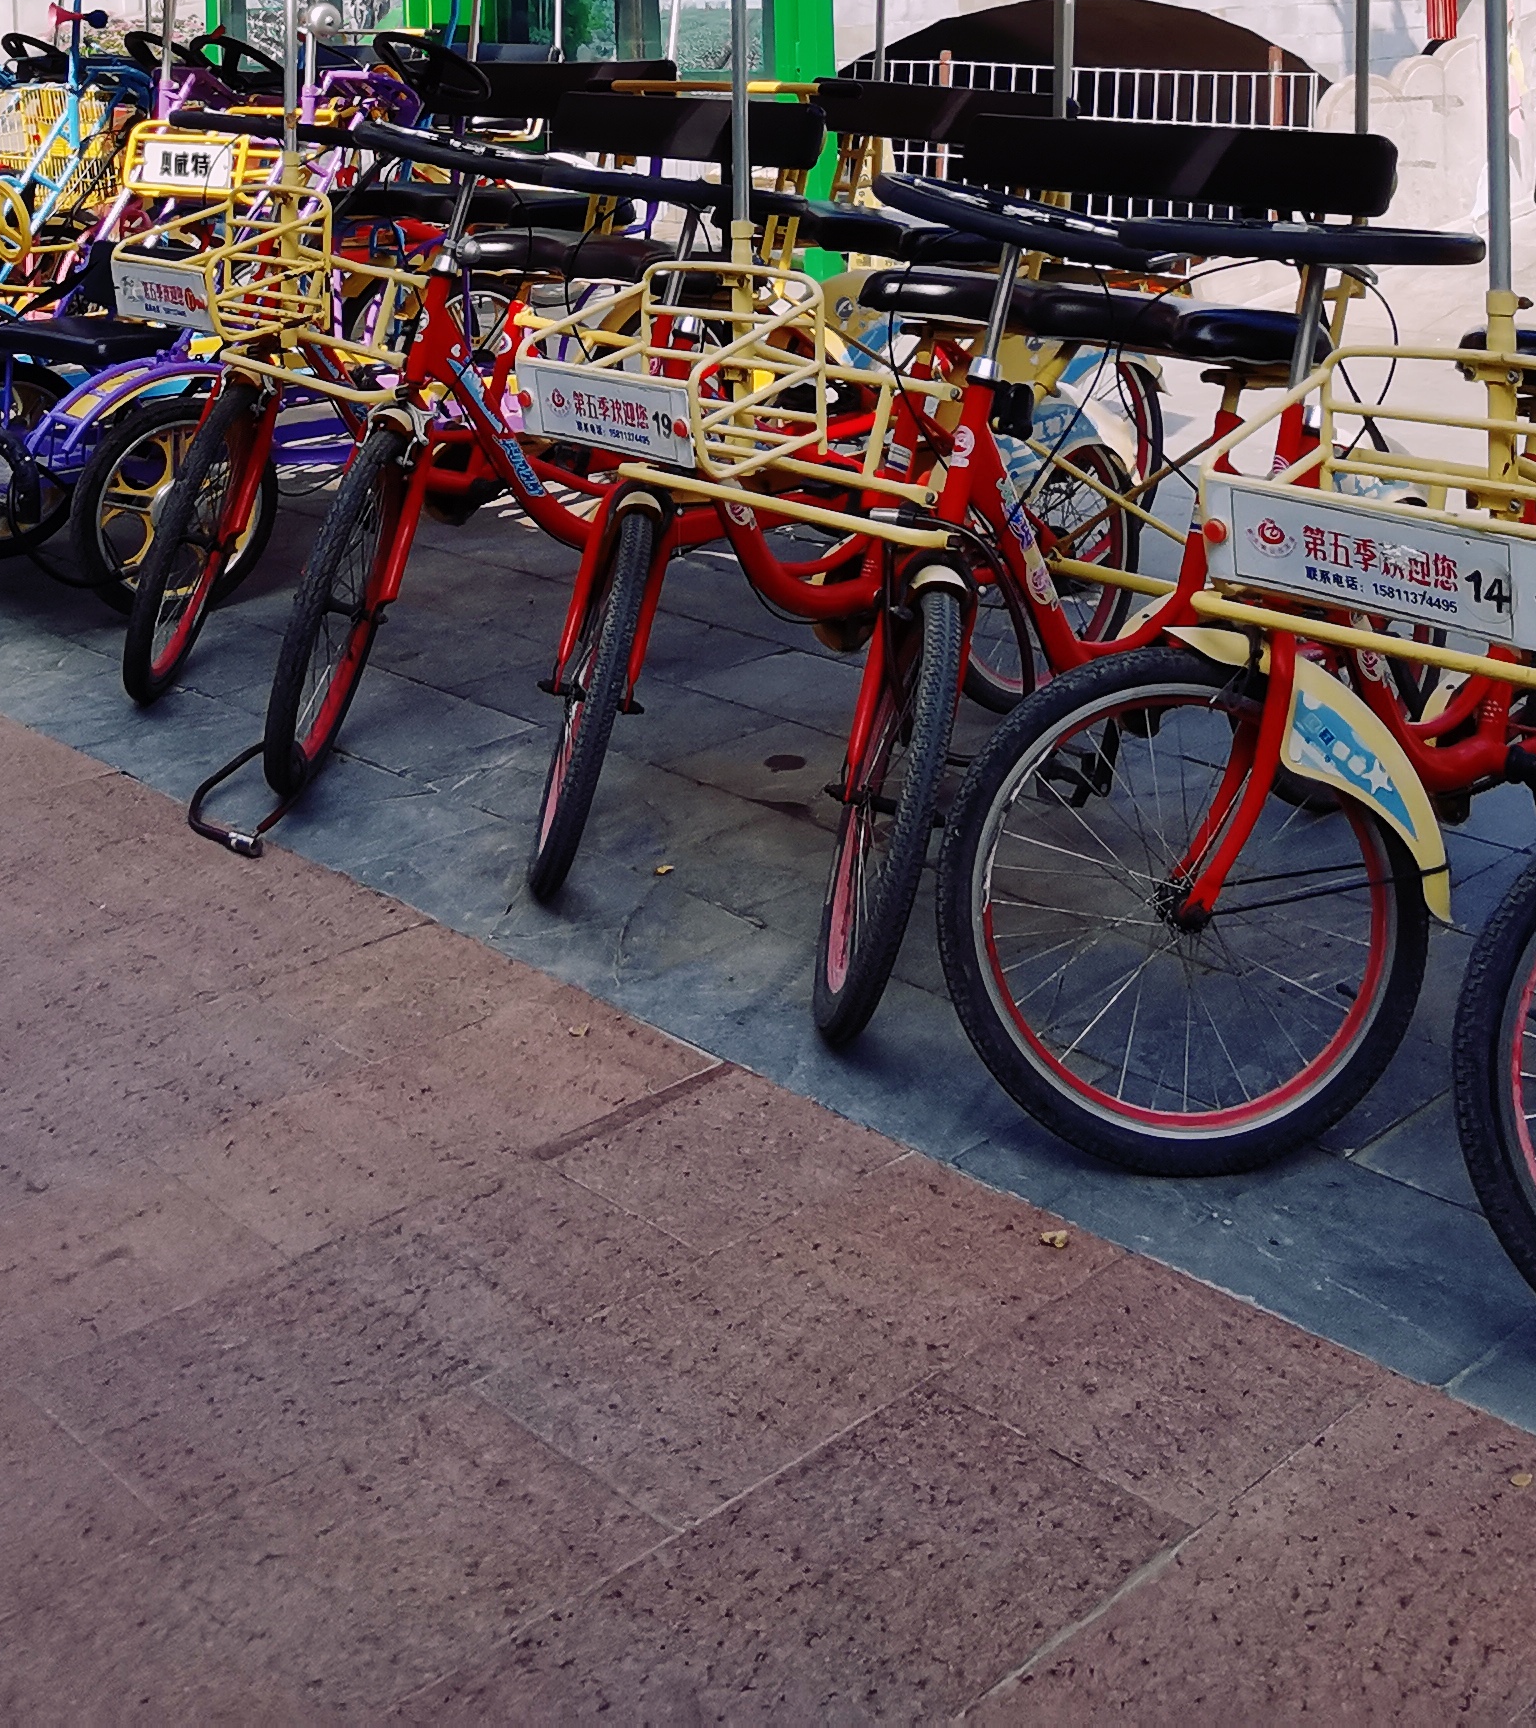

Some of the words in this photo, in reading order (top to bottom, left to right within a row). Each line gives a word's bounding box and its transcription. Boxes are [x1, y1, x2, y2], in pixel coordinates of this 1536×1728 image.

[572, 390, 650, 430] 第五季欢迎您
[652, 410, 673, 439] 19
[1371, 582, 1459, 614] 15811374495
[1464, 569, 1513, 614] 14
